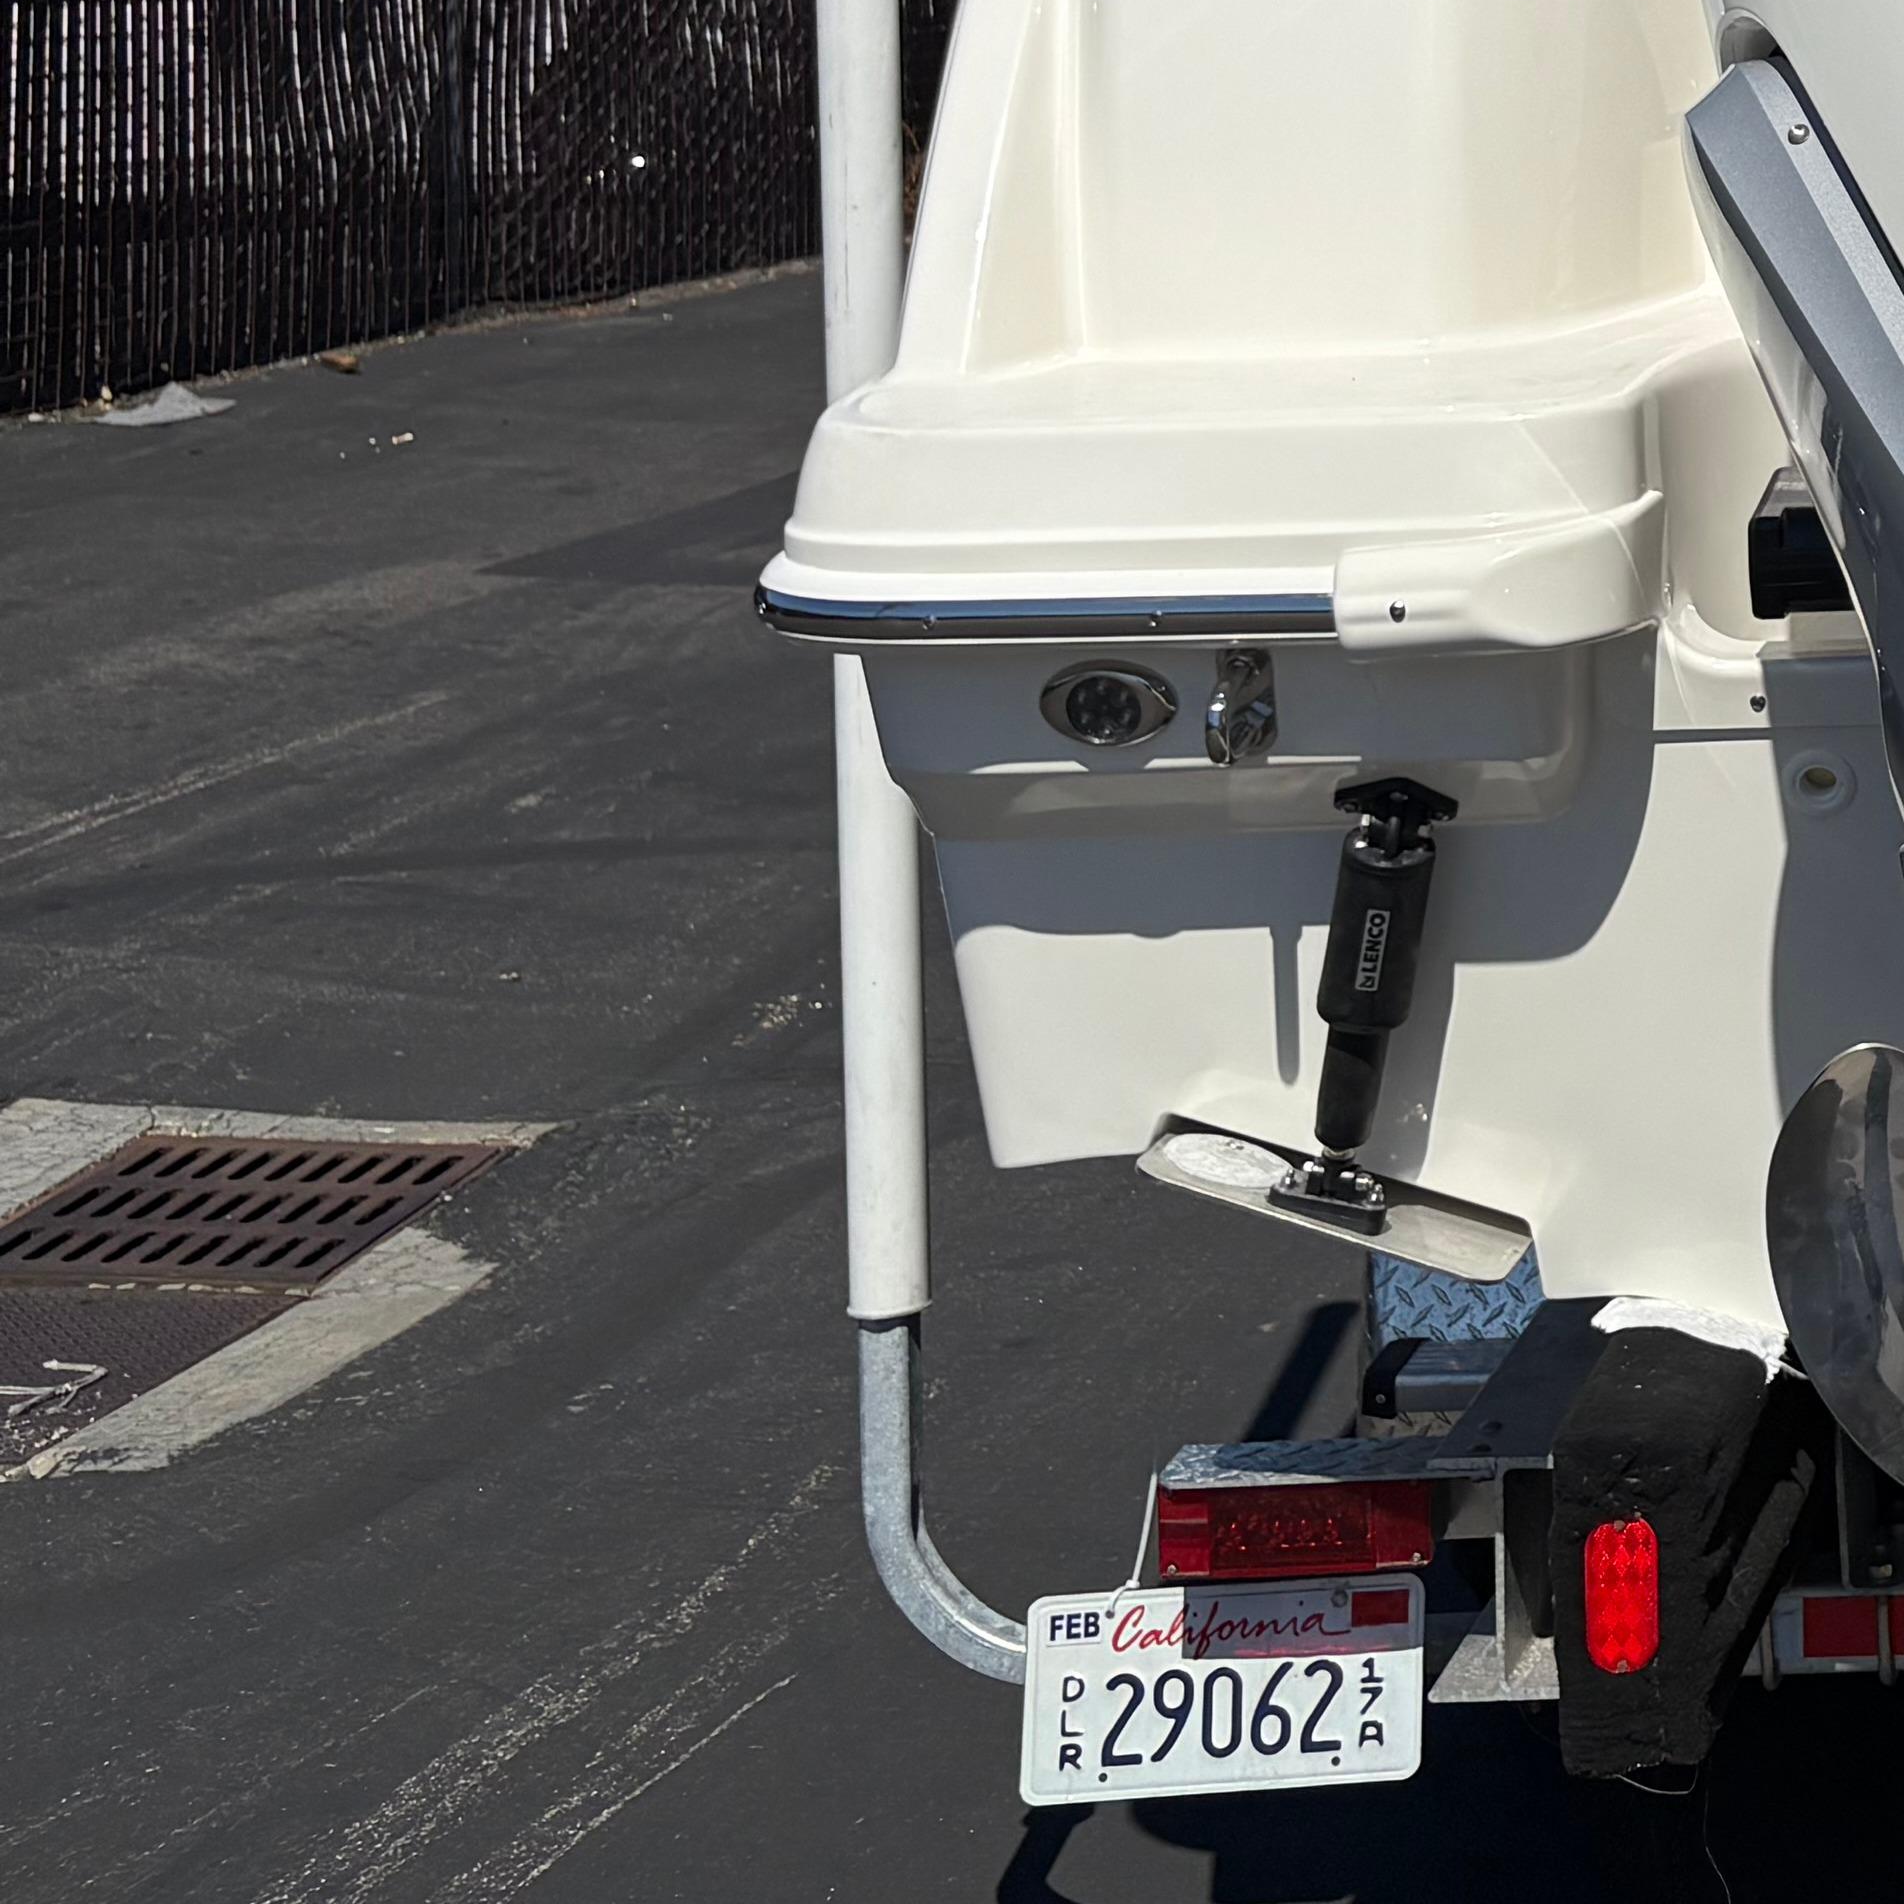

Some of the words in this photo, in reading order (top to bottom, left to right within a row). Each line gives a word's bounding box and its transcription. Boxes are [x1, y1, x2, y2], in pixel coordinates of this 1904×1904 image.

[1362, 912, 1386, 974] LENCO
[1050, 1611, 1100, 1642] FEB
[1111, 1600, 1351, 1660] California
[1101, 1659, 1344, 1767] 29062
